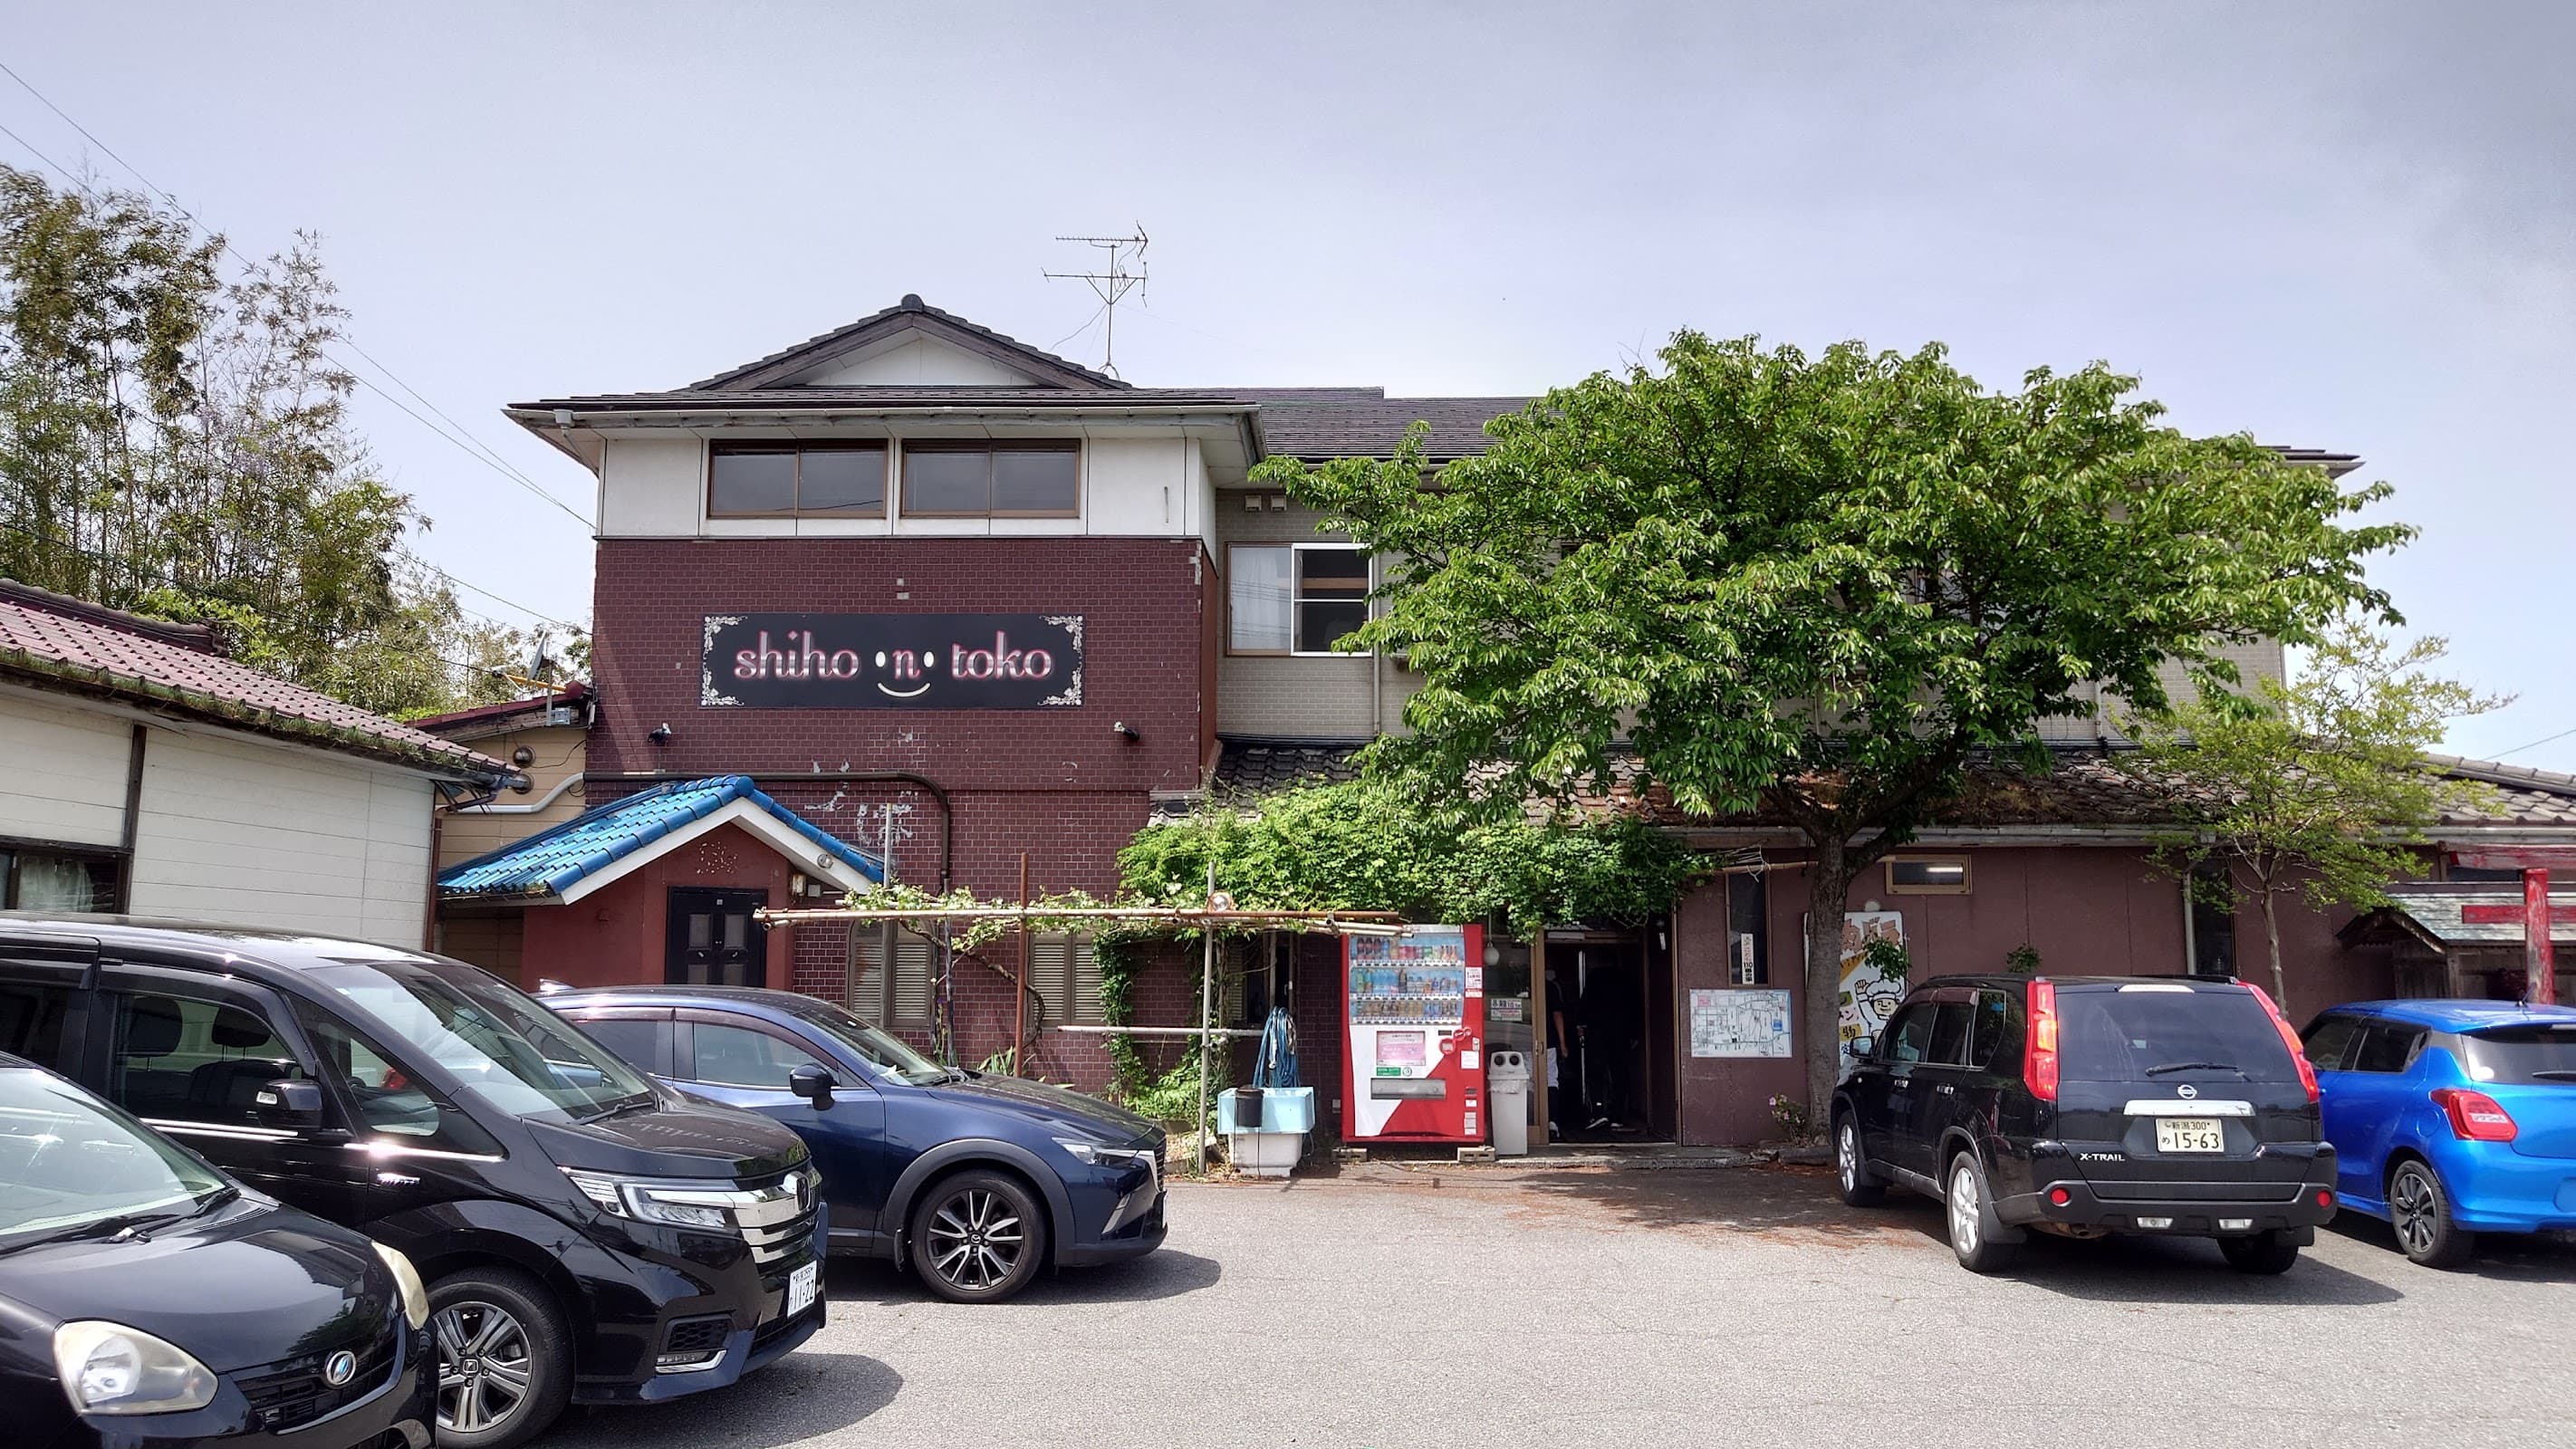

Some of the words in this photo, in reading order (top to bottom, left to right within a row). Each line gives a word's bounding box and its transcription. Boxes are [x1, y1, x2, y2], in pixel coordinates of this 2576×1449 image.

[734, 630, 860, 679] shiho
[892, 649, 922, 680] n
[951, 630, 1053, 679] toko
[2174, 1132, 2219, 1149] 15-63
[2080, 1153, 2126, 1162] X-TRAIL
